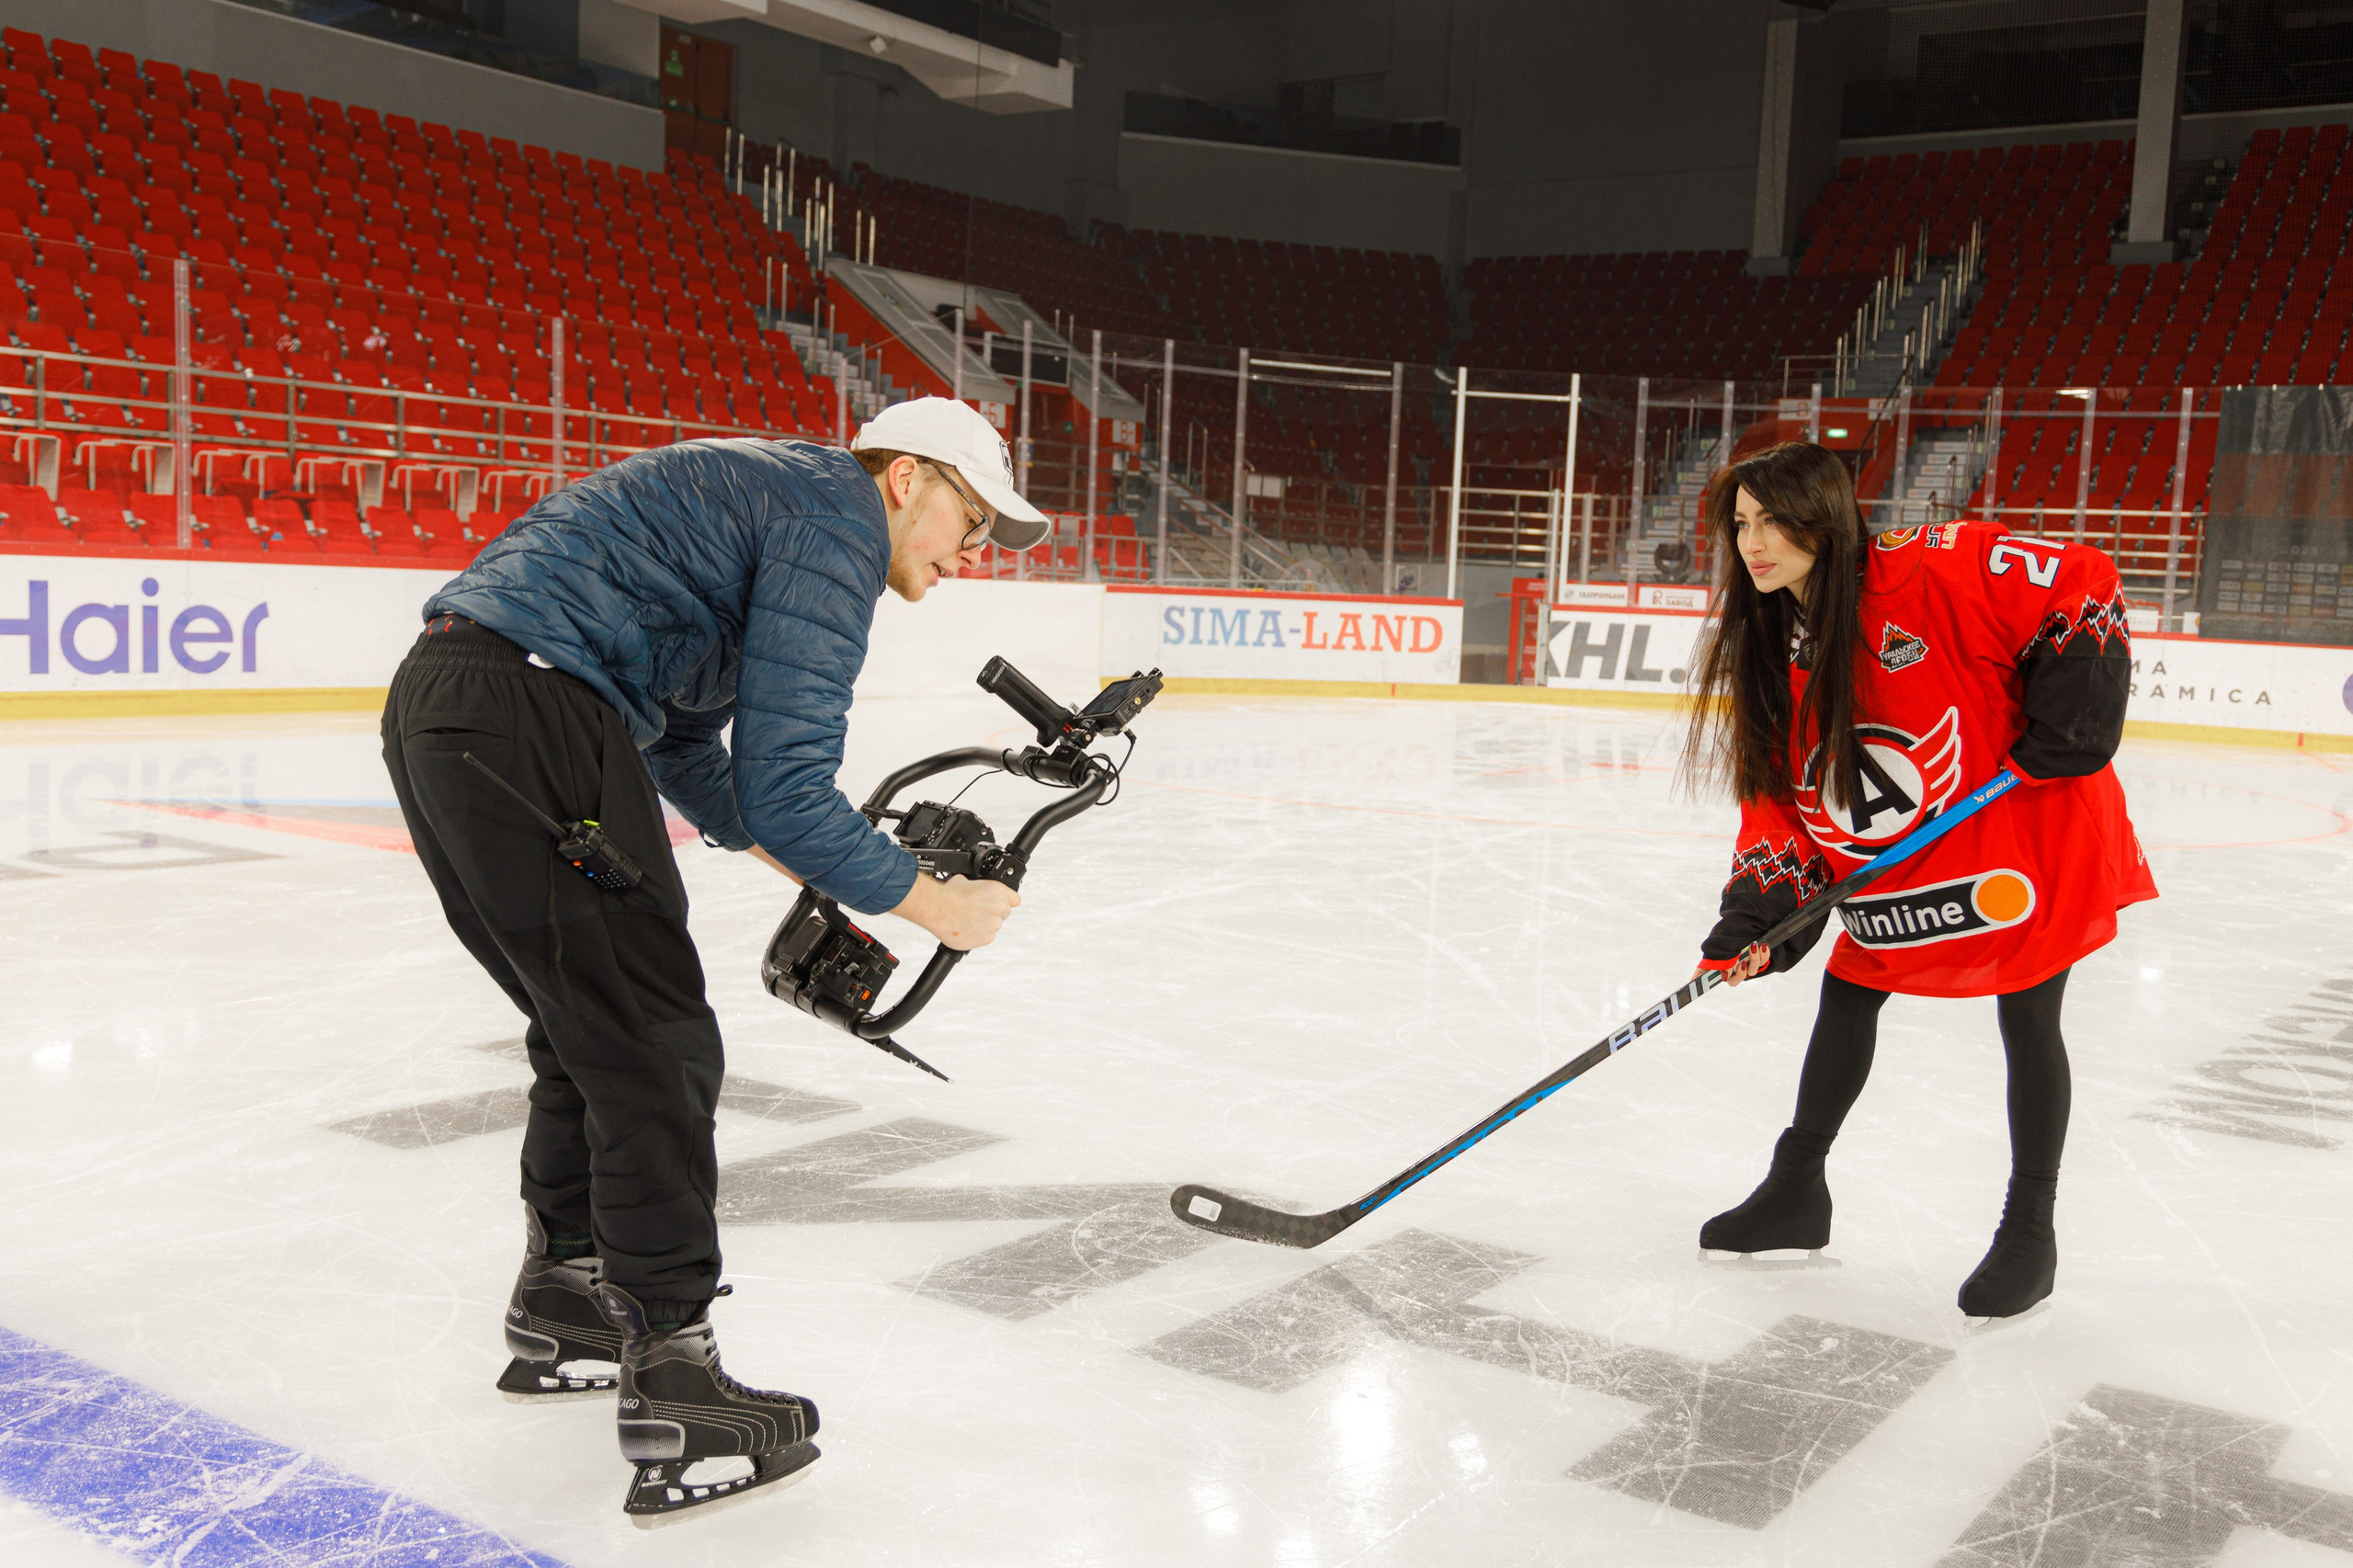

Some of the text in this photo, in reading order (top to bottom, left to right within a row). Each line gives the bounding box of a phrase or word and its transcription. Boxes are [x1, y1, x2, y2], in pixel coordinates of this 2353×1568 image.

[1987, 535, 2067, 589] 21
[0, 577, 269, 676] Haier
[1163, 606, 1444, 653] SIMA-LAND
[1845, 901, 1965, 937] Winline
